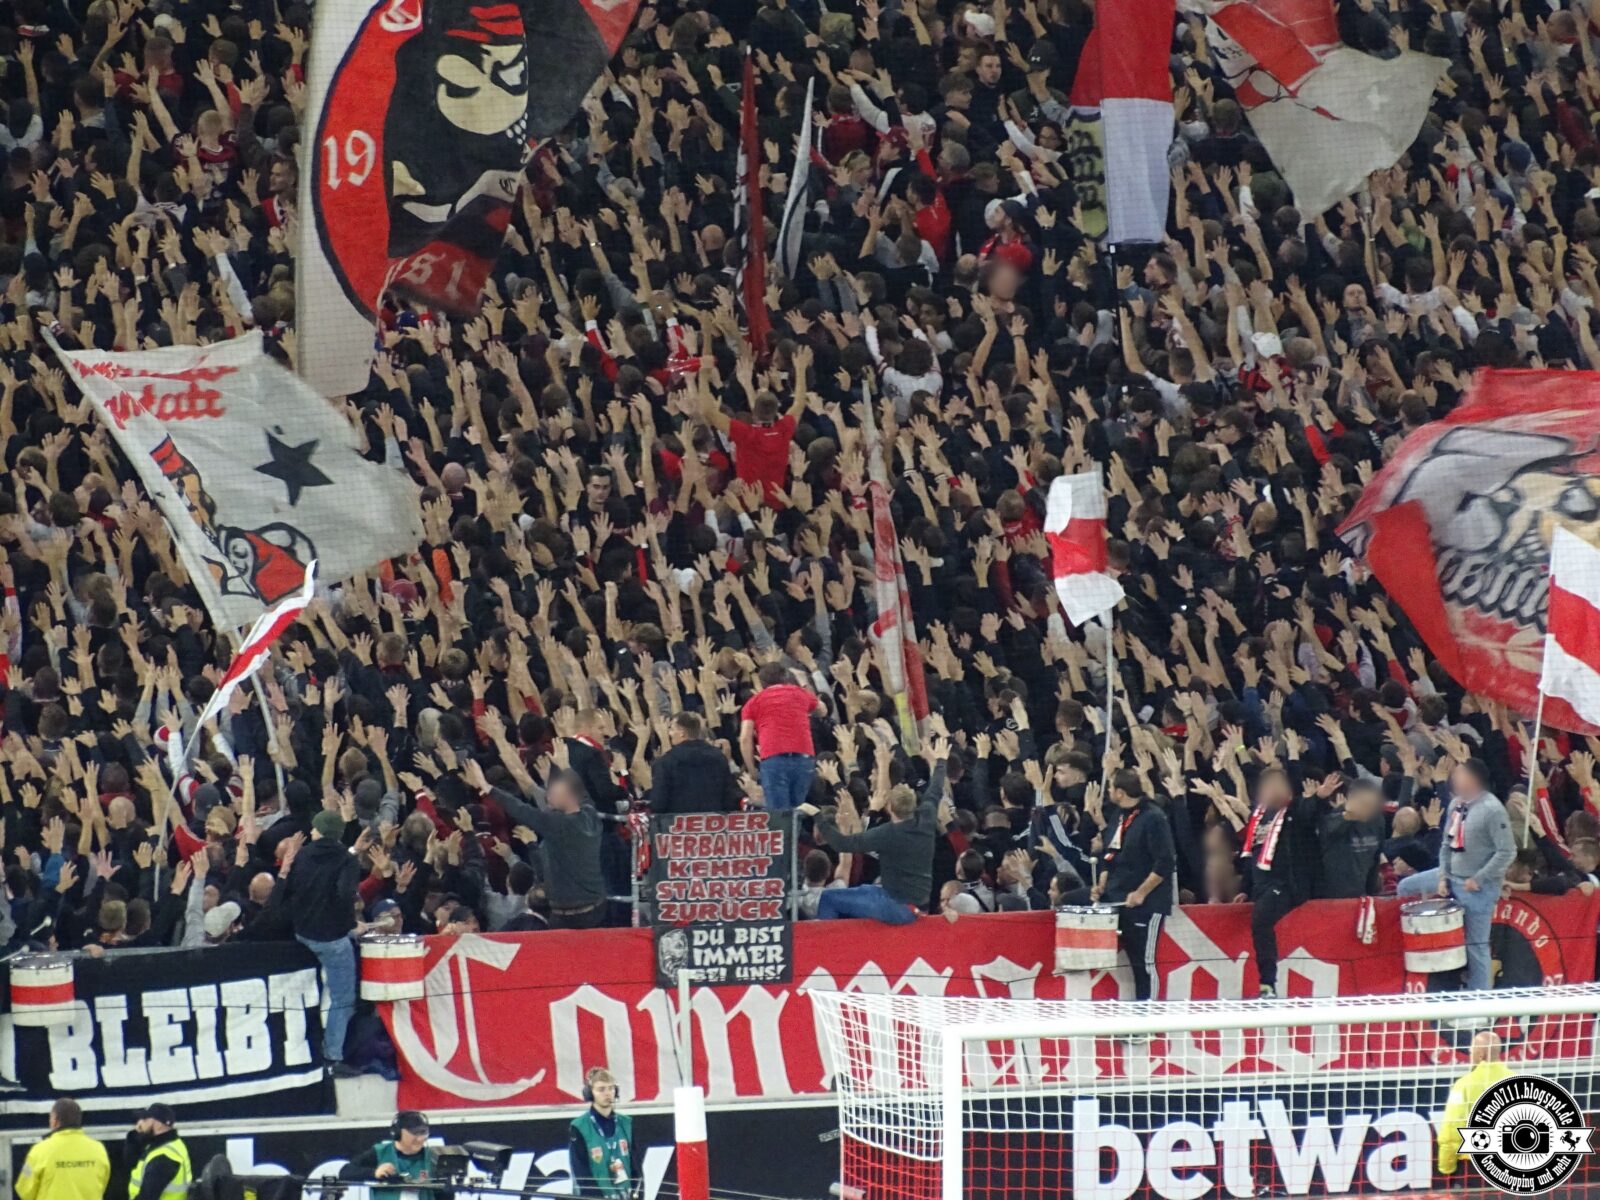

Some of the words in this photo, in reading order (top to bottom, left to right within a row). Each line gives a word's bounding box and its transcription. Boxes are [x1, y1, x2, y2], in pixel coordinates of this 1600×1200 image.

[323, 129, 377, 191] 19
[669, 812, 770, 834] JEDER
[655, 830, 784, 859] VERBANNTE
[668, 857, 773, 879] KEHRT
[658, 898, 783, 922] ZURÜCK
[692, 929, 725, 946] DU
[734, 926, 785, 944] BIST
[692, 945, 784, 966] IMMER
[735, 965, 786, 981] UNS!
[48, 967, 320, 1091] BLEIBT
[1073, 1100, 1438, 1200] betwa
[55, 1160, 96, 1169] SECURITY
